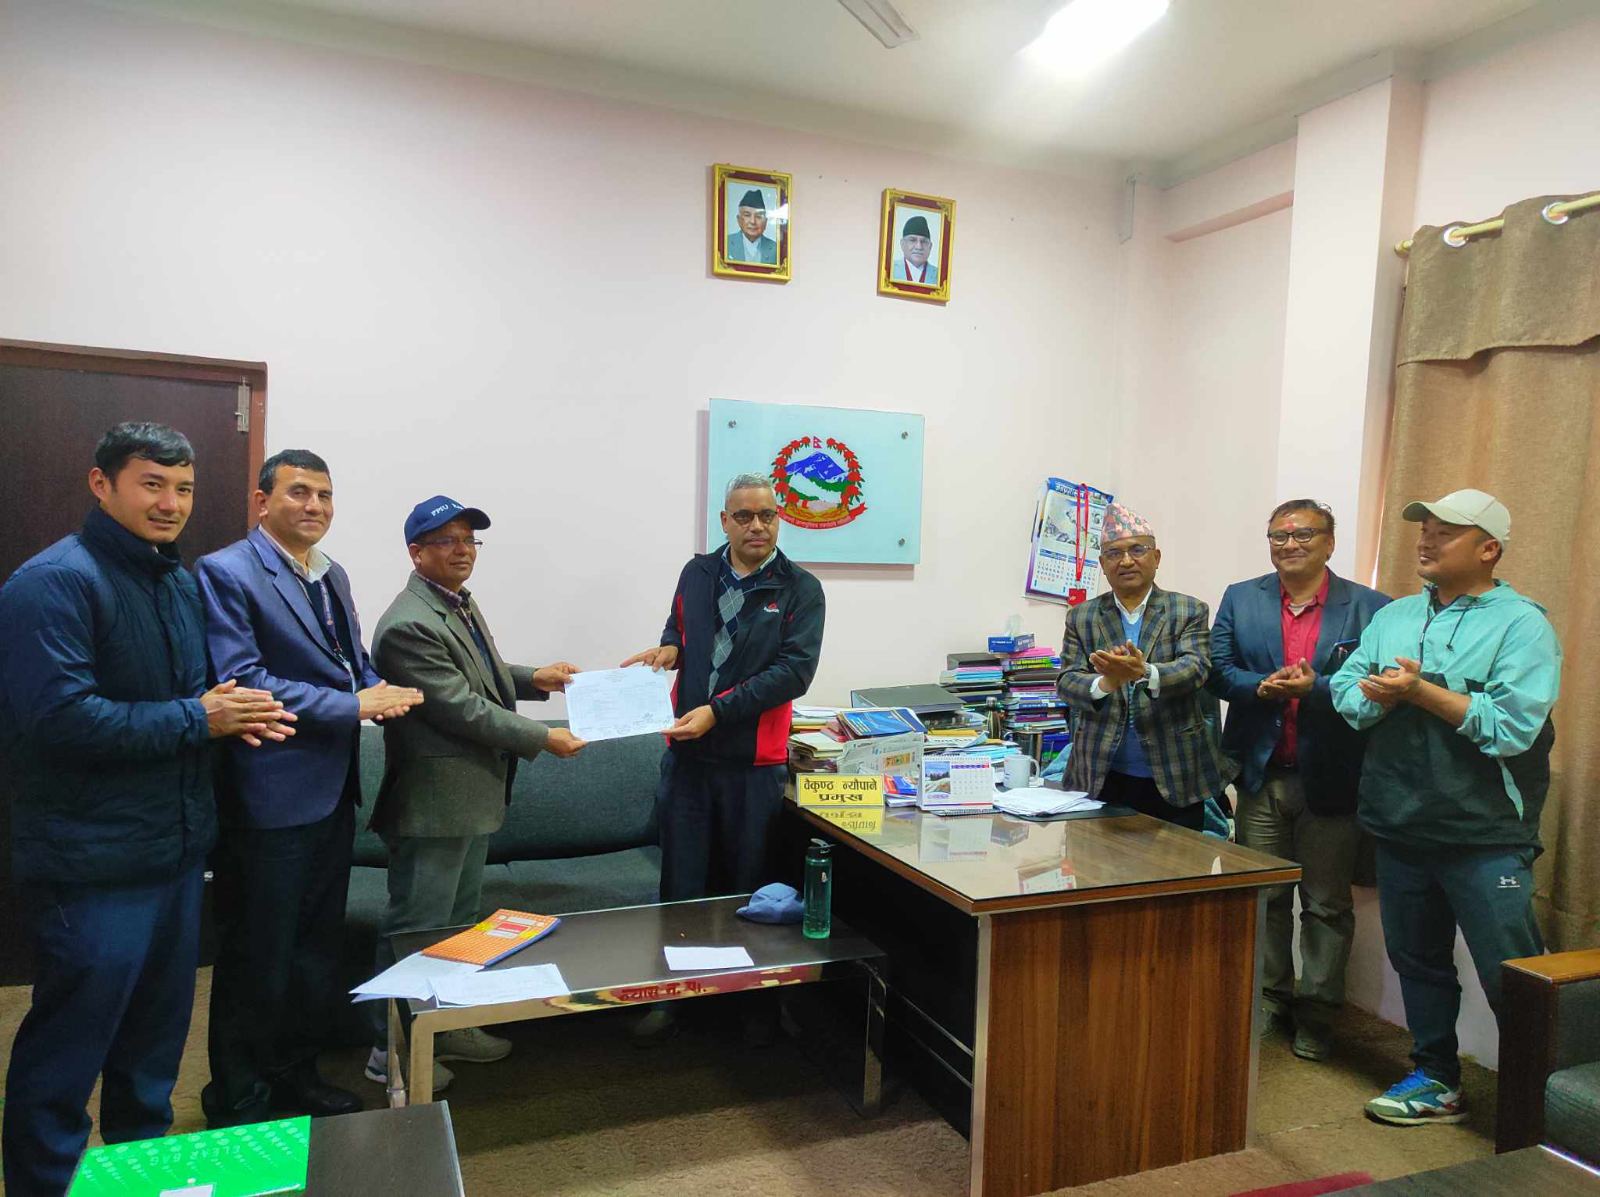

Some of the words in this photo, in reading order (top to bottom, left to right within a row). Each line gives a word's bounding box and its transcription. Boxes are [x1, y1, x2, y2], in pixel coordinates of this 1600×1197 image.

[819, 793, 863, 802] प्रमुख
[149, 1152, 182, 1167] BAG
[189, 1145, 241, 1160] CLEAR
